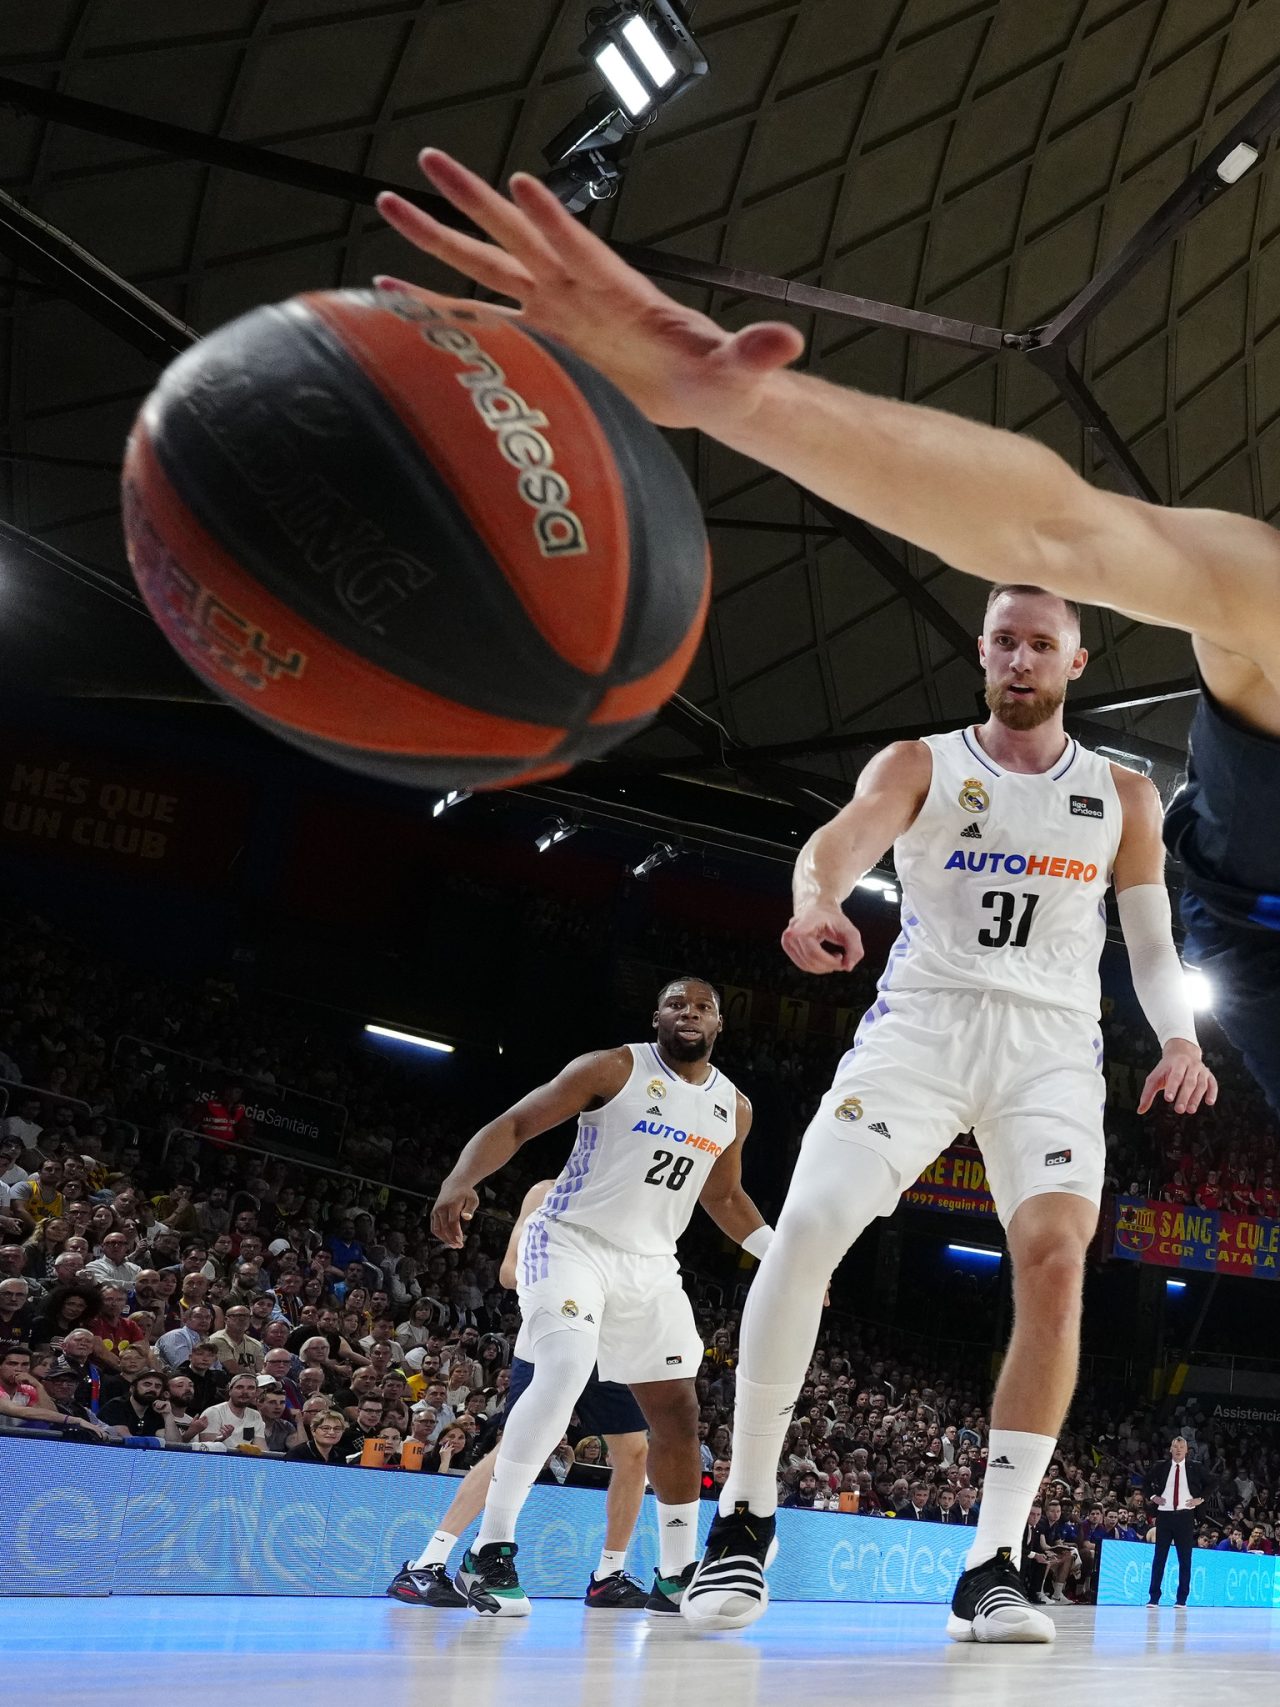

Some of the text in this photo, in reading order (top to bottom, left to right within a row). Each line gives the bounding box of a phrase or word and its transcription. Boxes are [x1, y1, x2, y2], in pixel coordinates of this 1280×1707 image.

[421, 323, 589, 558] endesa
[9, 761, 179, 824] MÉS QUE
[1072, 801, 1087, 810] liga
[2, 800, 168, 859] UN CLUB
[1072, 808, 1103, 817] endesa
[944, 850, 1098, 883] AUTOHERO
[978, 890, 1040, 948] 31
[632, 1119, 723, 1158] AUTOHERO
[644, 1149, 694, 1192] 28
[1047, 1156, 1067, 1165] acb
[905, 1190, 934, 1205] 1997
[938, 1198, 976, 1212] seguint
[979, 1203, 988, 1213] al
[1159, 1210, 1213, 1245] SANG
[1159, 1242, 1194, 1257] COR
